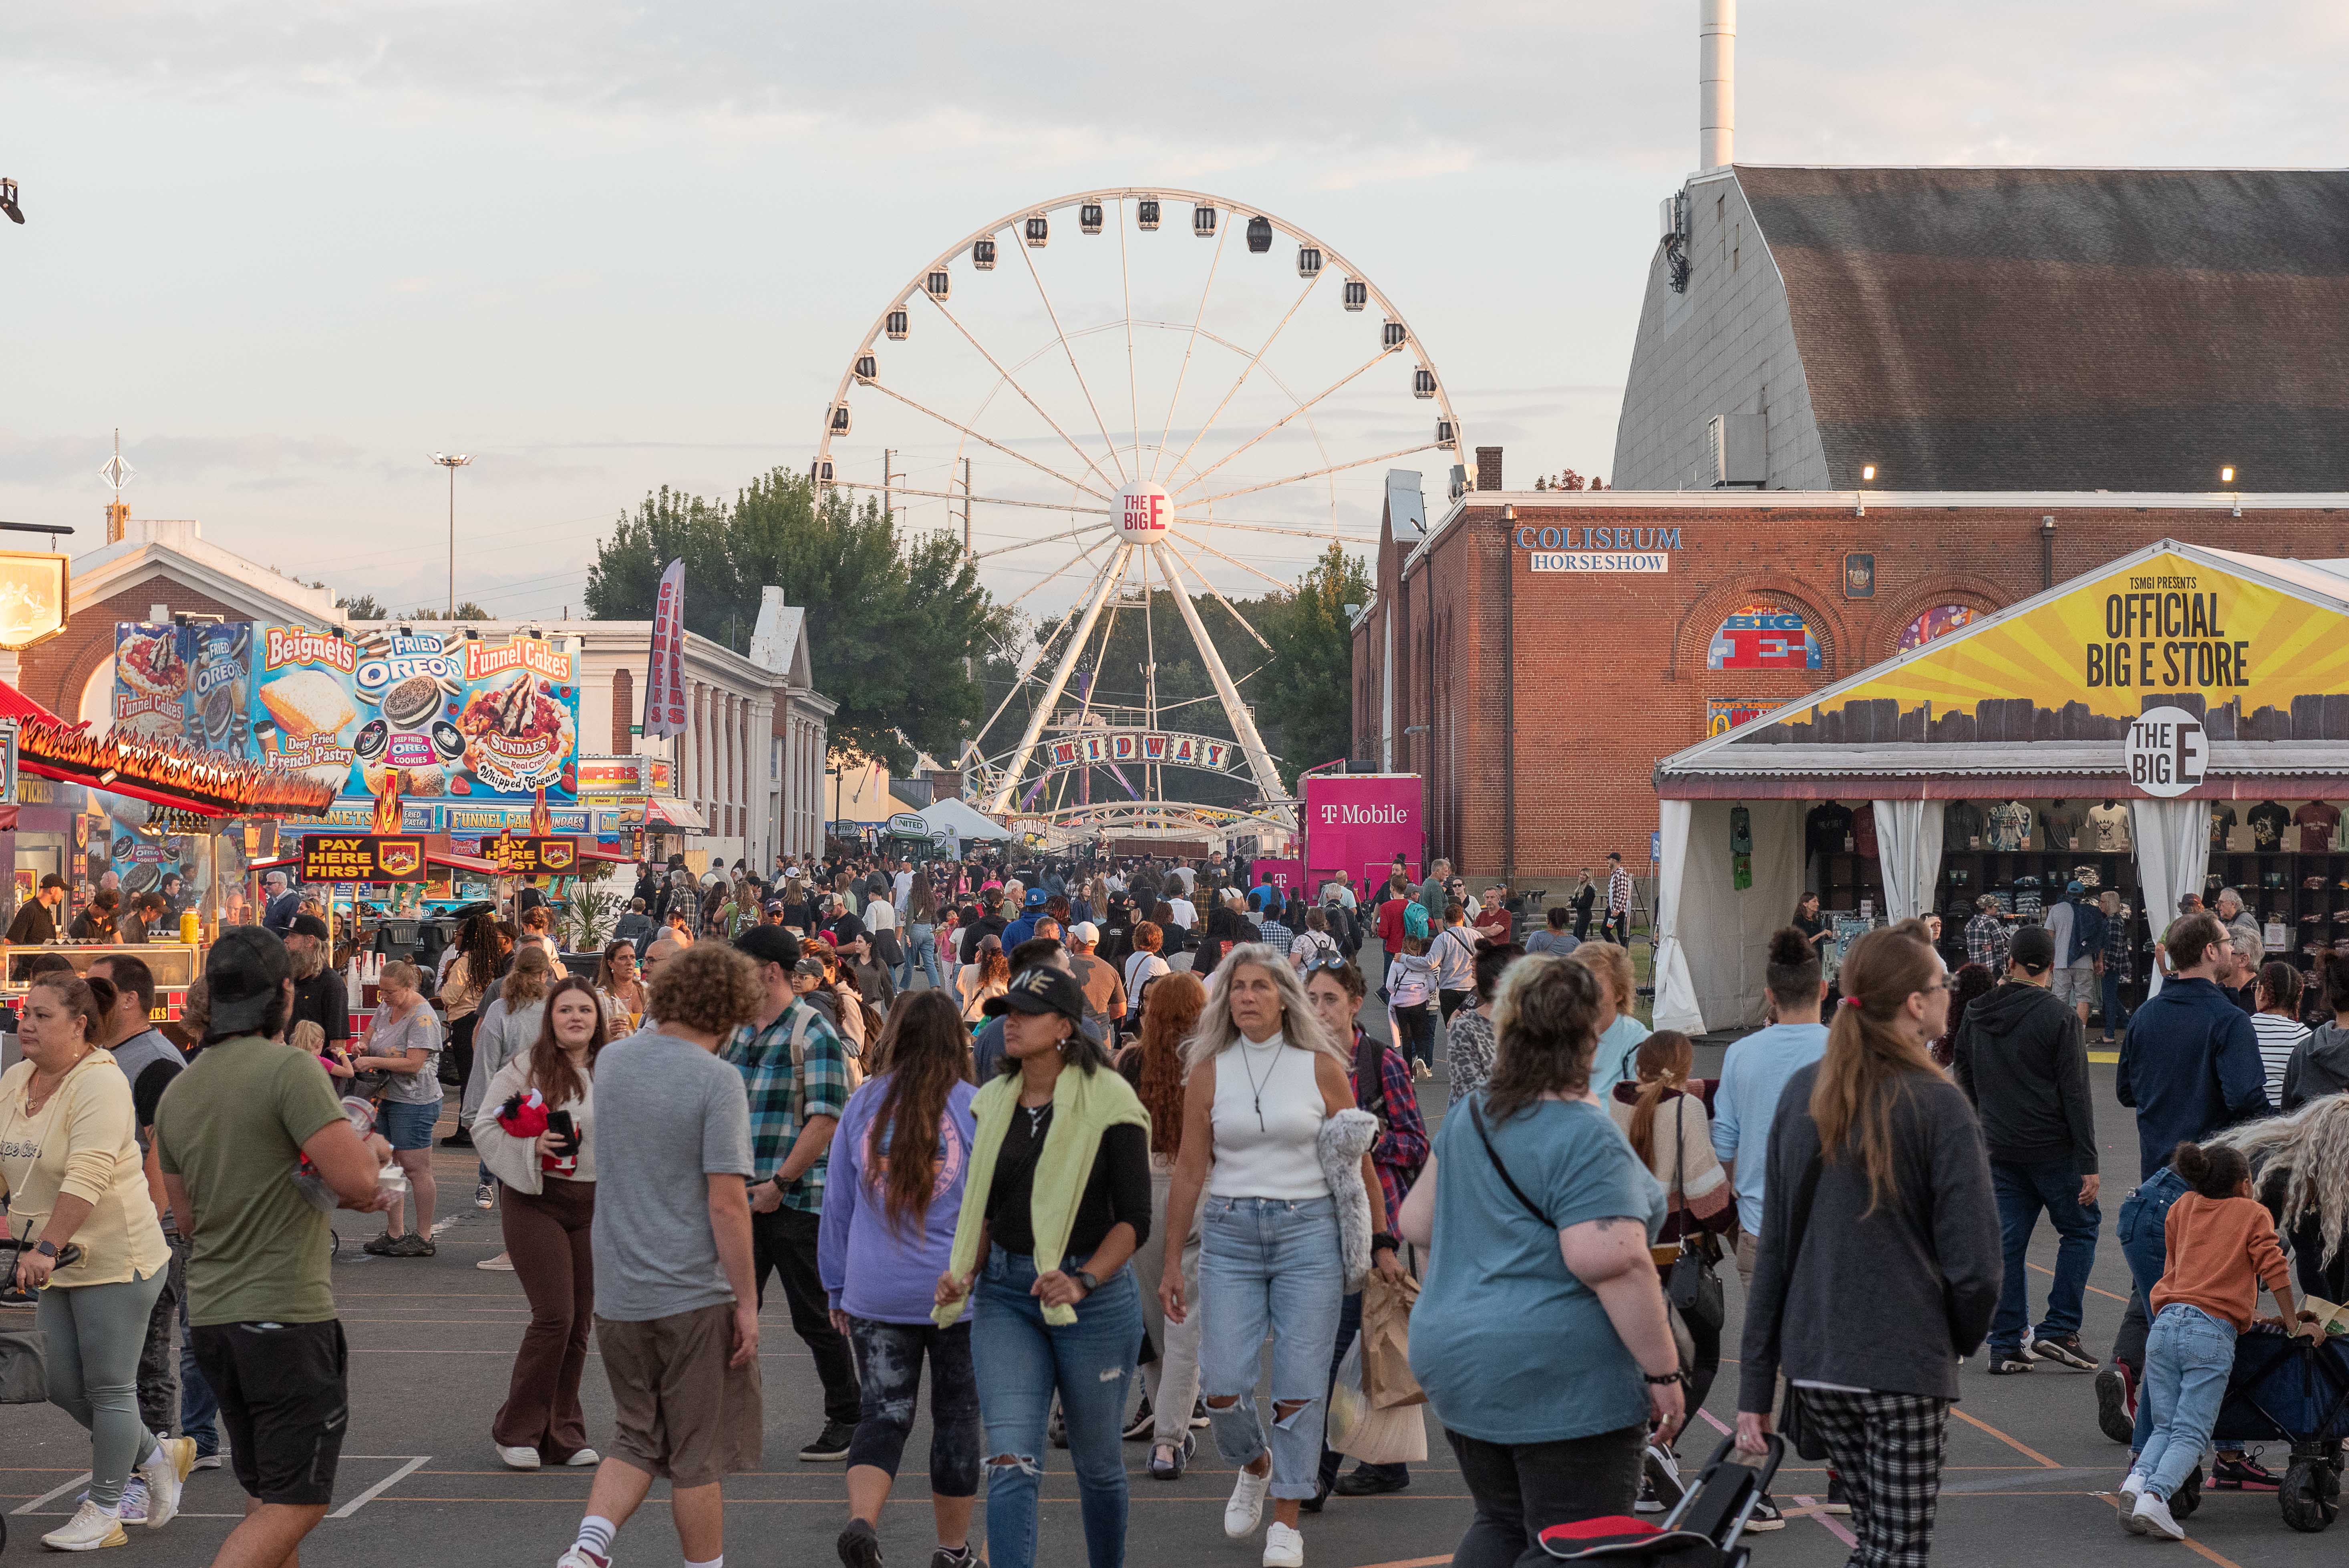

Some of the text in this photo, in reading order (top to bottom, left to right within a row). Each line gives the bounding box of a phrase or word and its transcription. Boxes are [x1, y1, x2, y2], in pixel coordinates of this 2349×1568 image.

[1124, 495, 1147, 510] THE
[1124, 512, 1148, 530] BIG
[1150, 495, 1165, 529] E
[1516, 526, 1683, 550] COLISEUM
[1534, 555, 1664, 570] HORSESHOW
[2130, 577, 2196, 590] TSMGI PRESENTS
[1752, 605, 1777, 615] THE
[2106, 592, 2224, 638] OFFICIAL
[1723, 616, 1807, 629] BIG
[209, 640, 231, 660] FRIED
[269, 631, 356, 670] Beignets
[395, 635, 441, 655] FRIED
[650, 582, 672, 723] CHOMPERS
[1723, 630, 1807, 668] E
[468, 640, 568, 680] Funnel Cakes
[2087, 641, 2249, 687] BIG E STORE
[119, 694, 183, 721] Funnel Cakes
[1731, 710, 1759, 728] NOT
[288, 733, 335, 751] Deep Fried
[491, 735, 547, 755] SUNDAES
[2132, 723, 2171, 749] THE
[268, 746, 354, 769] French Pastry
[392, 744, 429, 755] OREO
[1054, 737, 1224, 766] MIDWAY
[2176, 723, 2201, 784] E
[394, 756, 427, 764] COOKIES
[487, 749, 500, 761] made
[511, 760, 528, 769] Real
[529, 753, 551, 769] Cream
[480, 765, 560, 789] Whipped Cream
[2132, 754, 2170, 784] BIG
[404, 810, 421, 819] FRIED
[404, 818, 428, 827] PASTRY
[452, 811, 584, 829] FUNNEL CAK UNDAES
[602, 815, 616, 830] COLD
[1322, 804, 1407, 824] T Mobile
[894, 818, 923, 829] UNITED
[1009, 819, 1046, 837] LEMONADE
[319, 839, 364, 851] PAY
[383, 845, 416, 859] BUTCHER
[451, 840, 474, 849] FUNNEL
[500, 845, 509, 856] HERE
[309, 853, 372, 864] HERE
[485, 850, 535, 859] HRE
[499, 856, 509, 869] FIRST
[306, 866, 374, 877] FIRST
[1275, 874, 1286, 888] T
